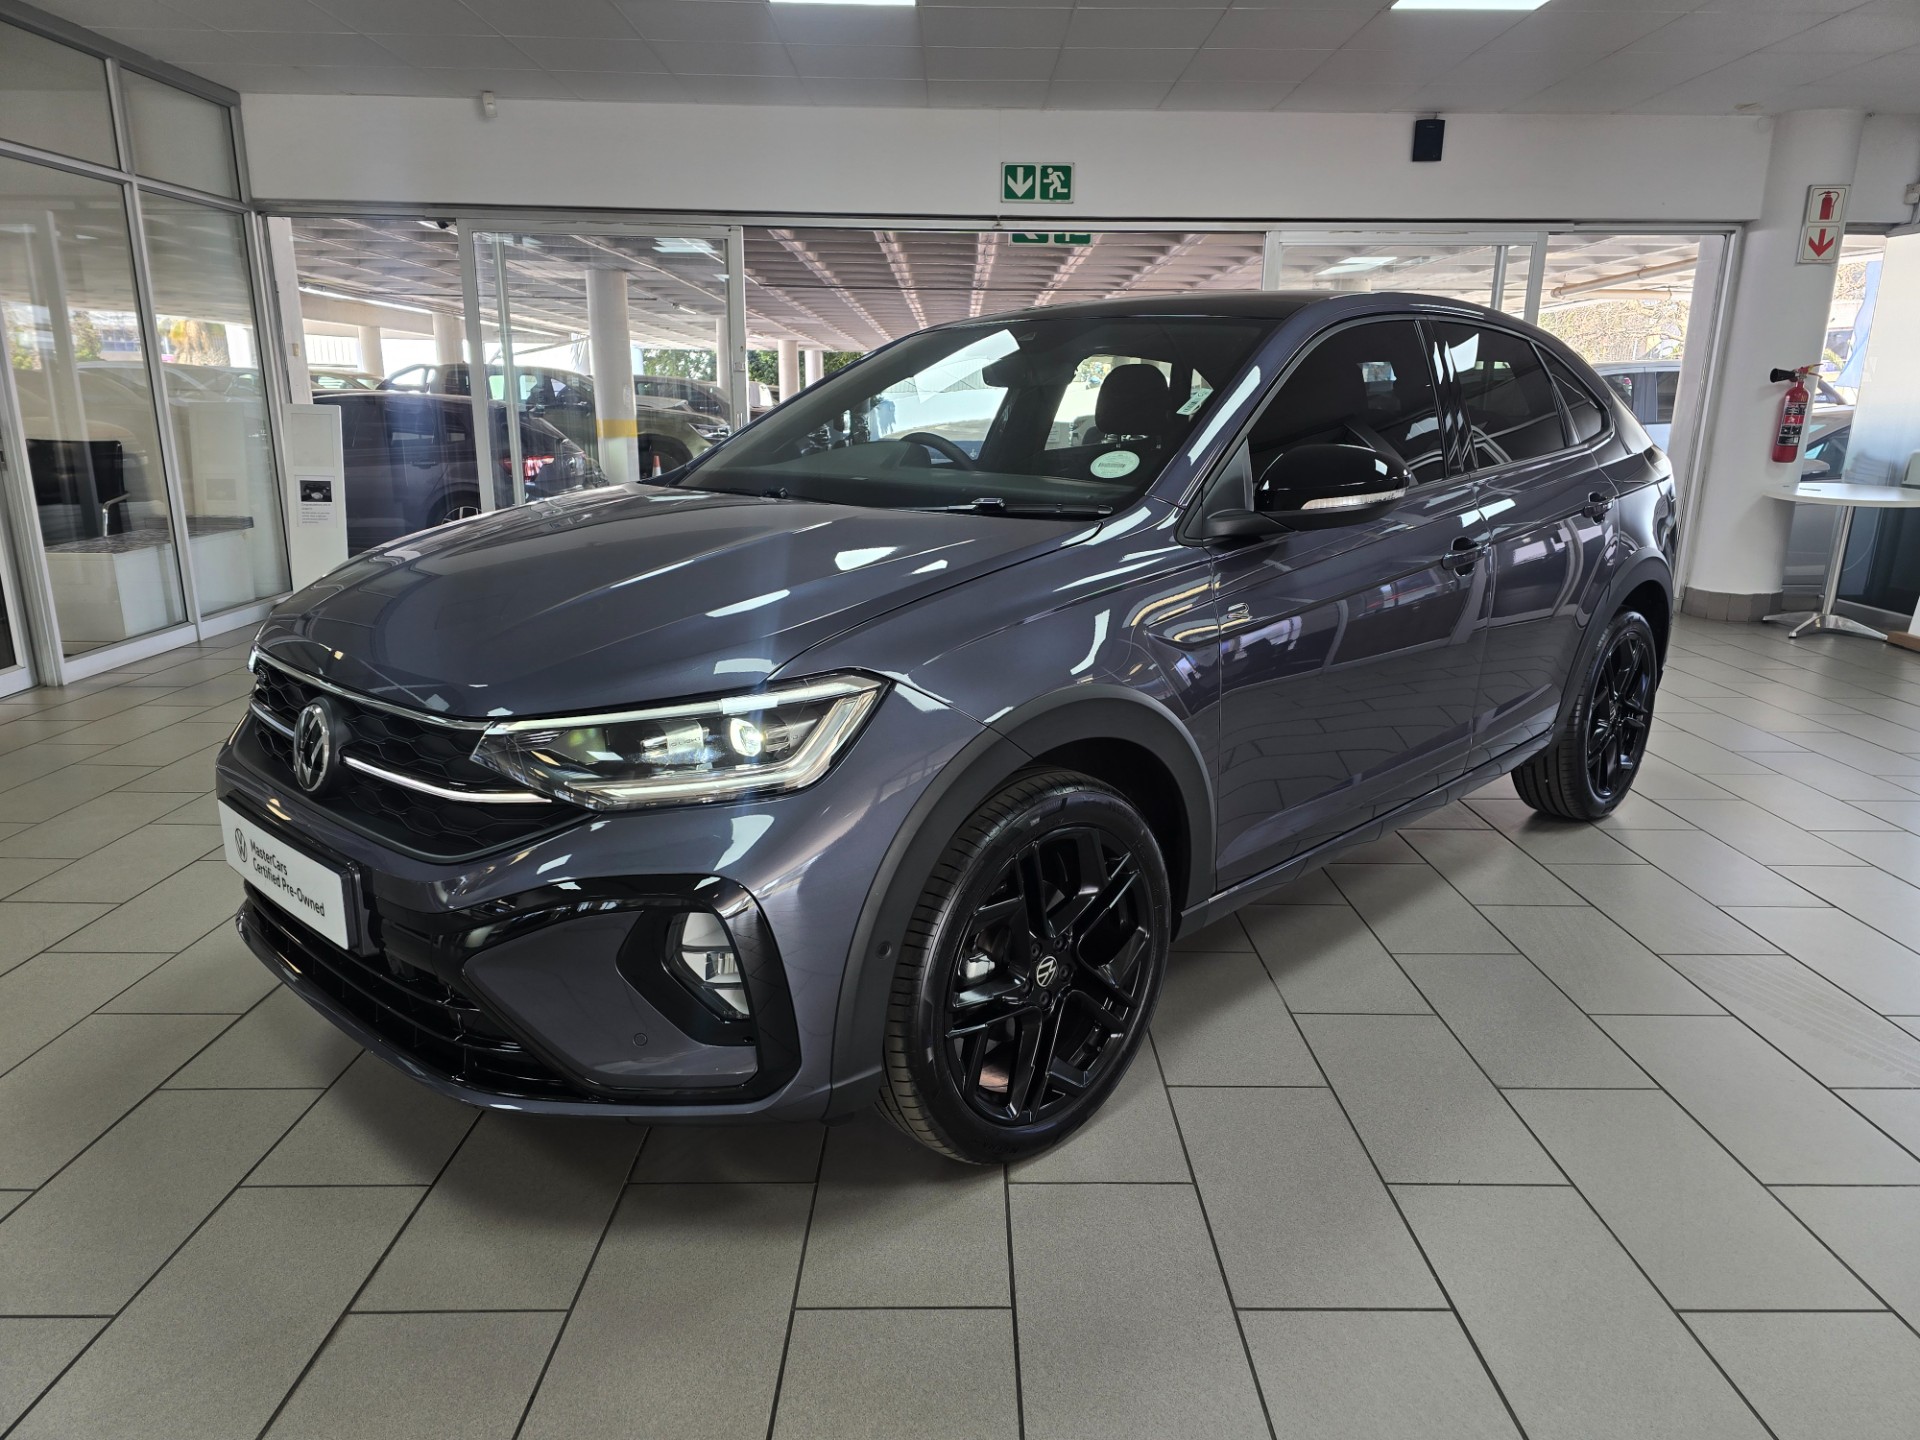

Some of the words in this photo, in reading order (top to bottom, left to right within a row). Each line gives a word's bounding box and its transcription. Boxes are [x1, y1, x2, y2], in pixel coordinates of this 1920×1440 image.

[250, 839, 288, 876] MasterCars
[253, 857, 281, 888] Certified
[281, 877, 325, 917] Pre-Owned
